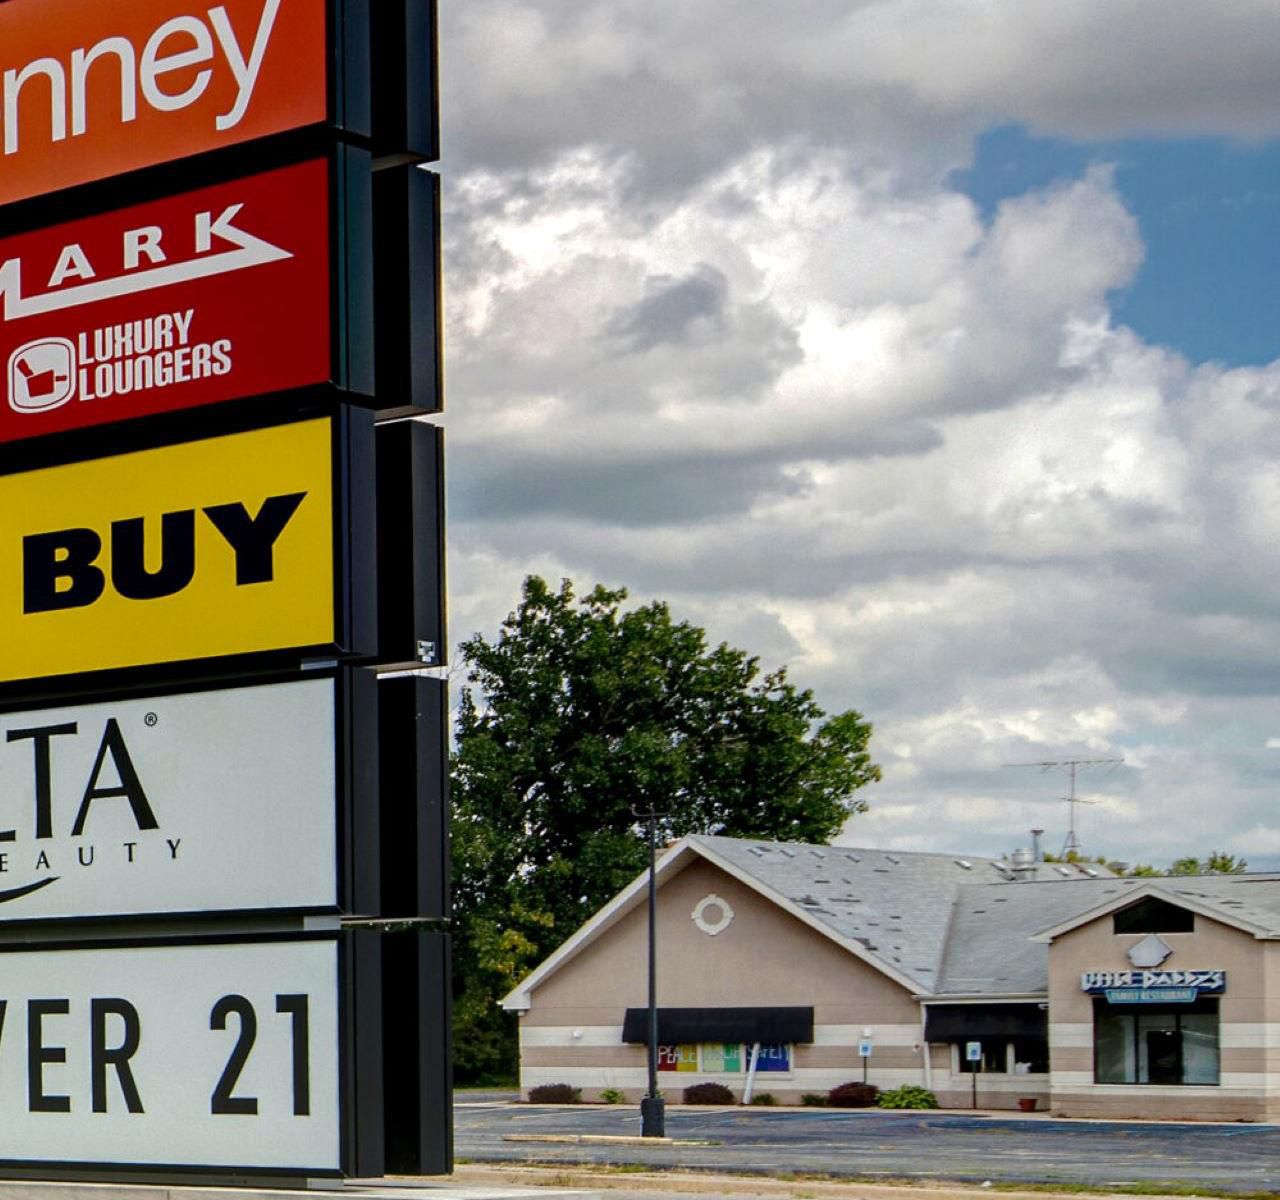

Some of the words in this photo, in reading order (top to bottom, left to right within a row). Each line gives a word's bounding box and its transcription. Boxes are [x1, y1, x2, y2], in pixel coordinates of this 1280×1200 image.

[78, 309, 194, 365] LUXURY
[78, 339, 232, 401] LOUNGERS
[22, 491, 308, 615] BUY
[209, 993, 310, 1116] 21
